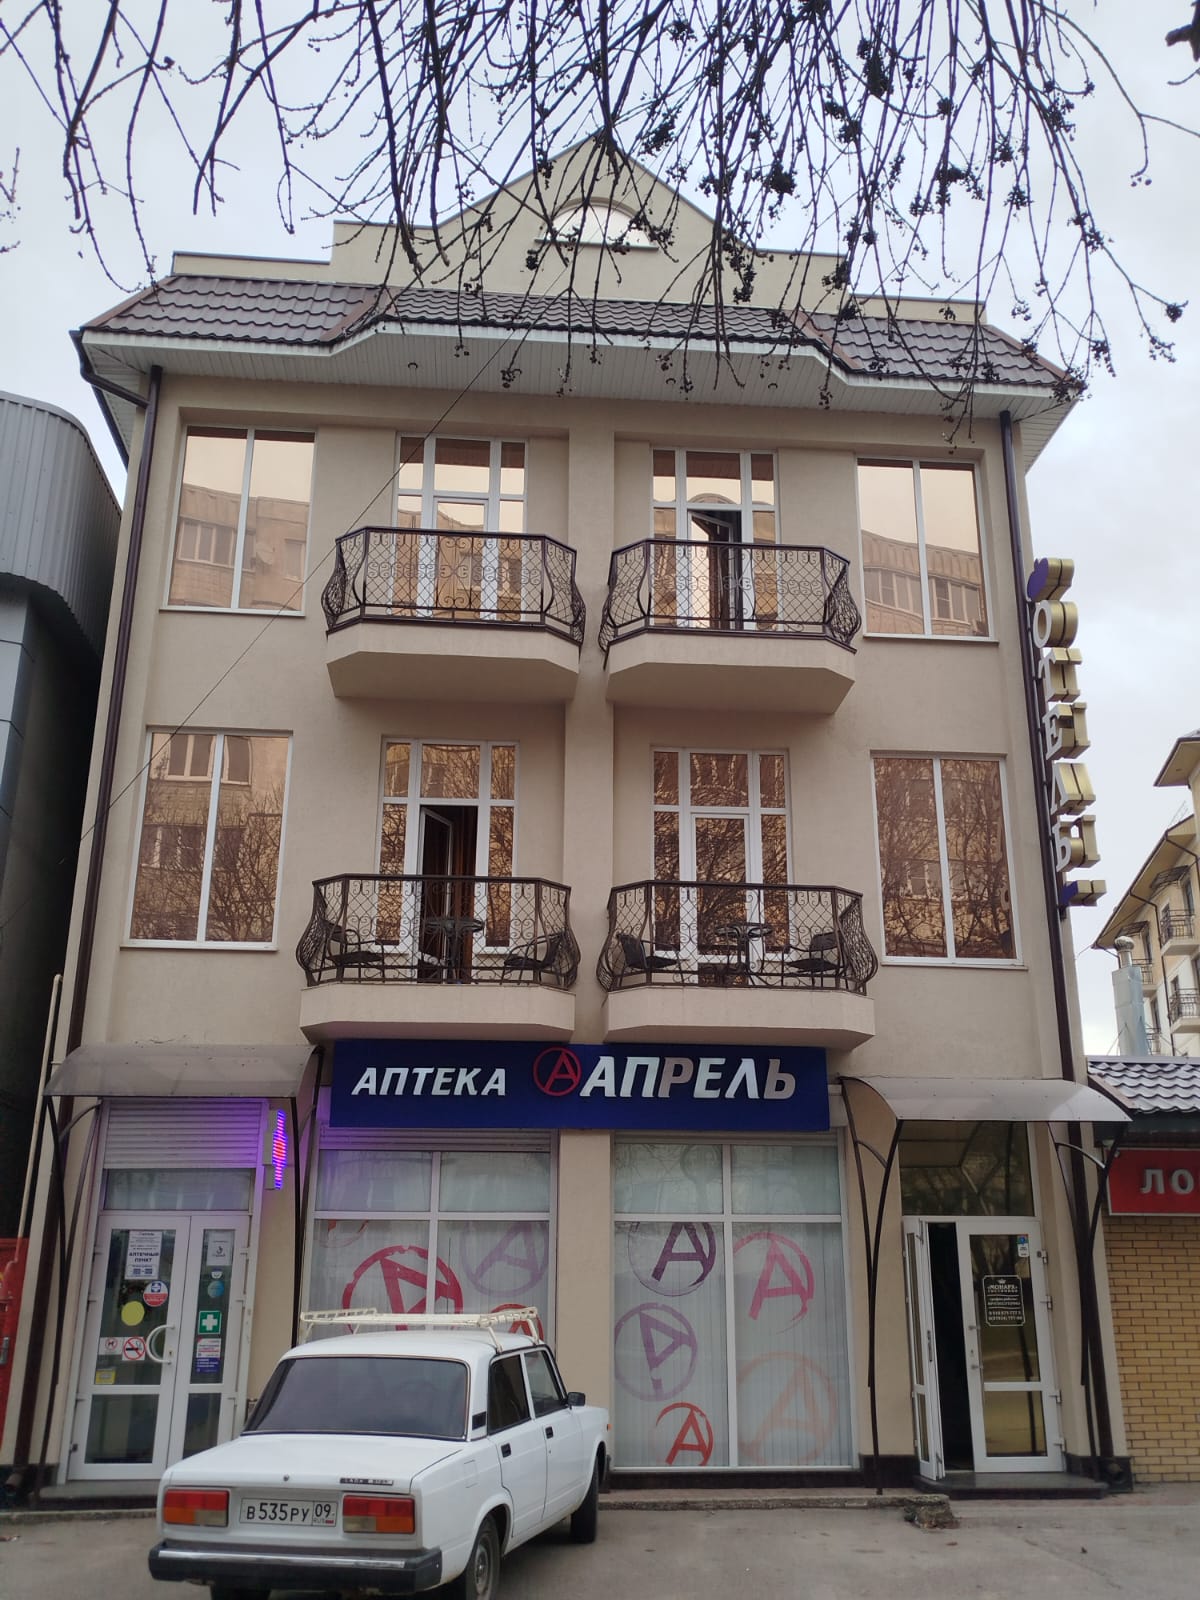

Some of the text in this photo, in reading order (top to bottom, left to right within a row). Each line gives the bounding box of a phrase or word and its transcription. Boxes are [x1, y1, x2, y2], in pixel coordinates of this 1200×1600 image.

[1033, 600, 1092, 873] ОТЕЛЬ
[351, 1067, 506, 1096] АПТЕКА
[579, 1055, 796, 1100] АПРЕЛЬ
[1140, 1167, 1200, 1195] ЛО
[315, 1503, 332, 1518] 09
